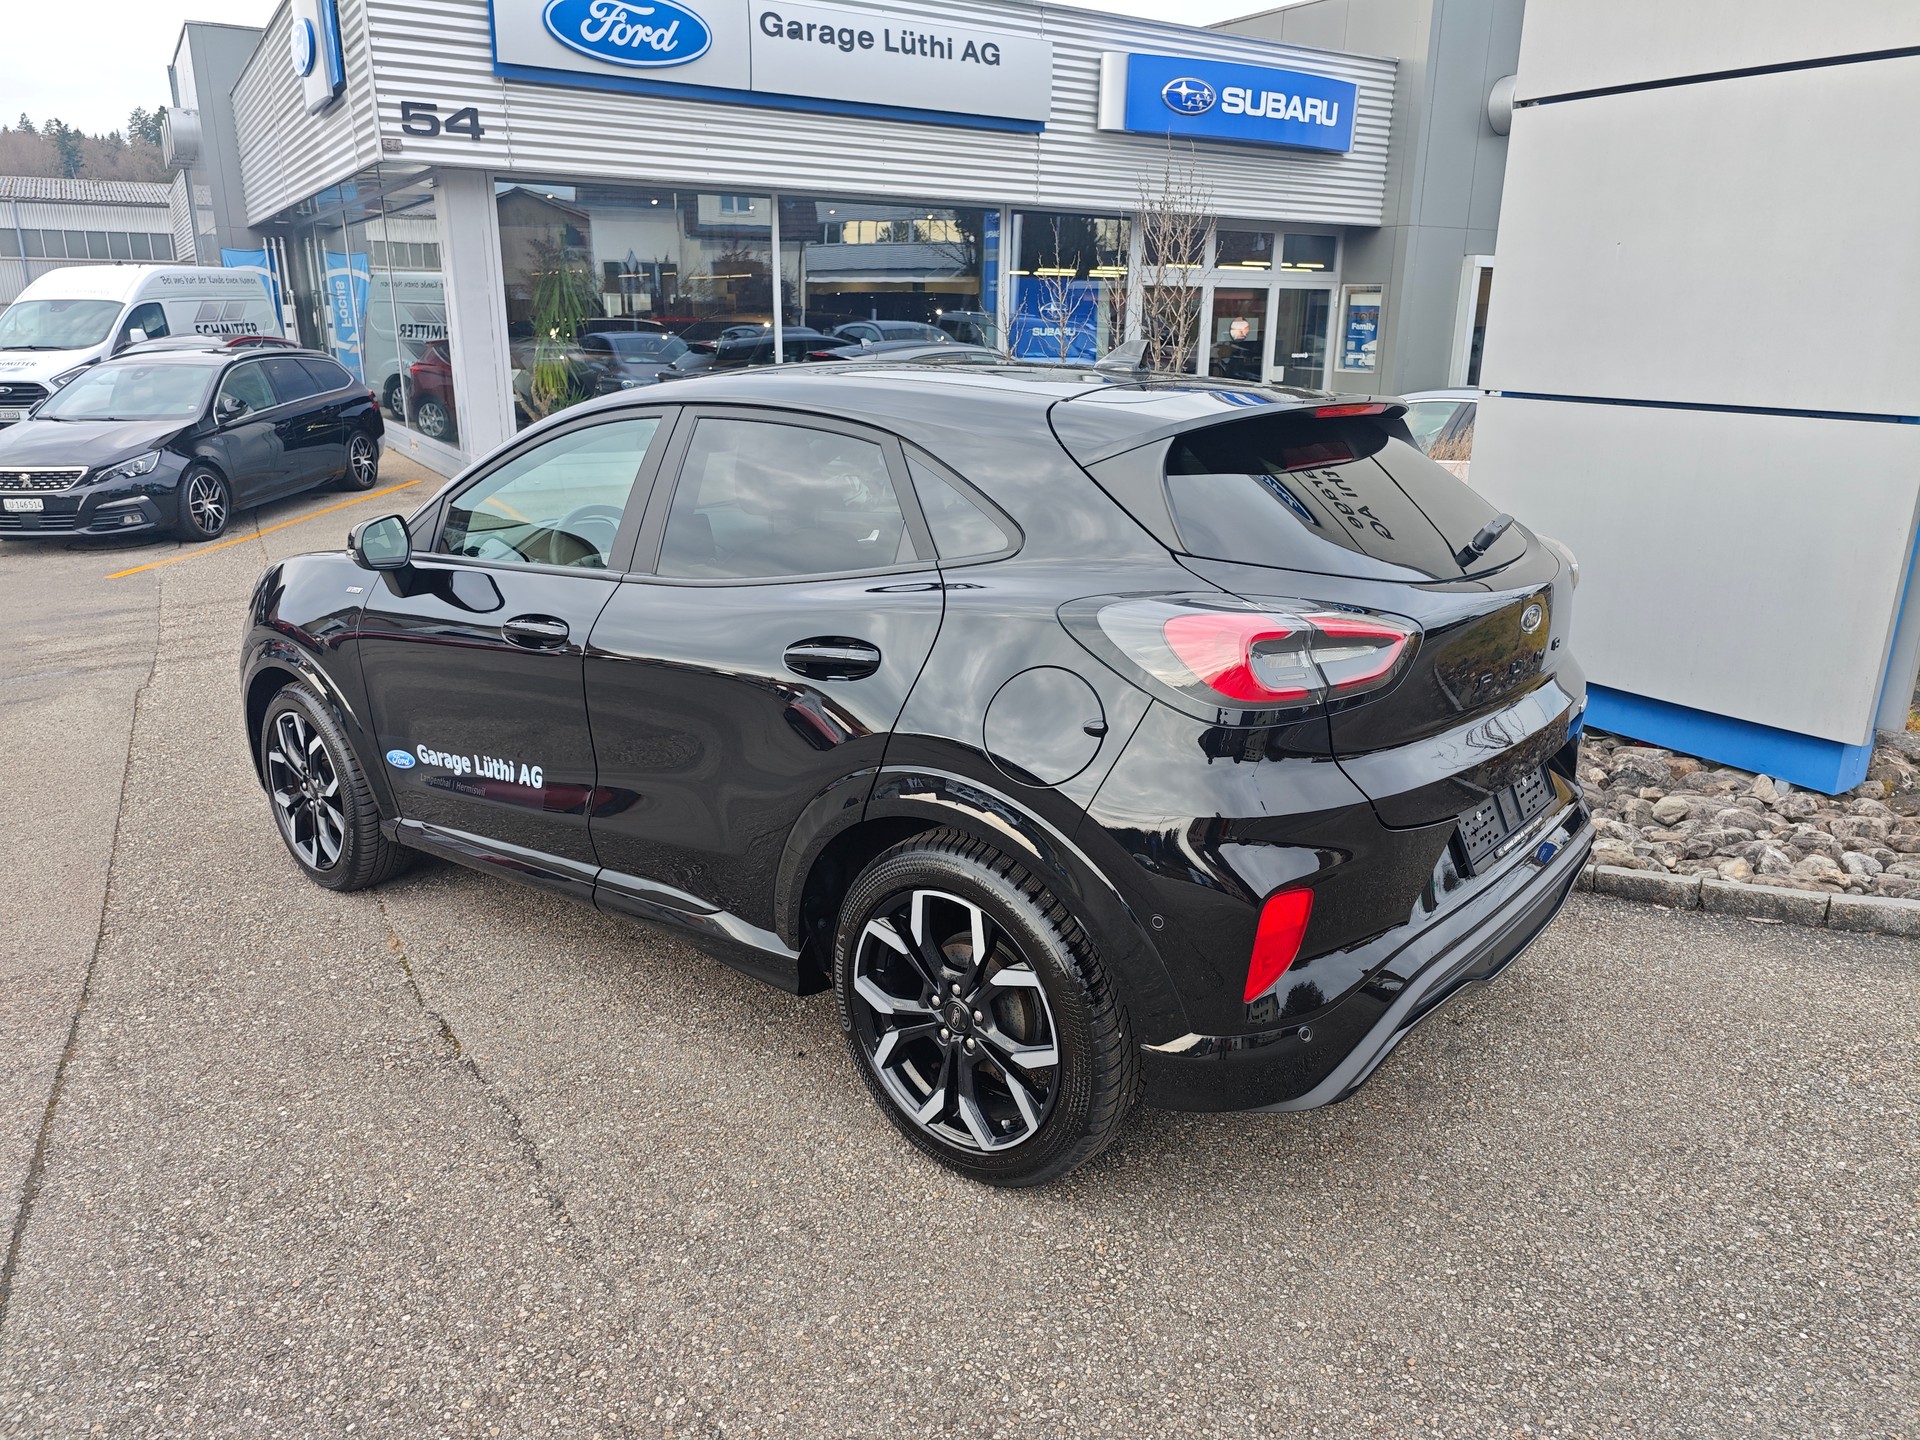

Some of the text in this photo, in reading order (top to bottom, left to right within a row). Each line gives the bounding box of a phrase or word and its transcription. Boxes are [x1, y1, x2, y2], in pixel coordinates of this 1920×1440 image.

[580, 0, 680, 52] Ford
[760, 11, 1000, 66] Garage Lüthi AG
[401, 101, 485, 141] 54
[1221, 86, 1339, 127] SUBARU
[1351, 322, 1376, 332] Family
[392, 752, 410, 766] Ford
[416, 744, 543, 789] Garage Lüthi AG
[420, 773, 451, 788] Langenthal
[456, 781, 487, 797] Hermiswil
[835, 943, 852, 1032] Continental
